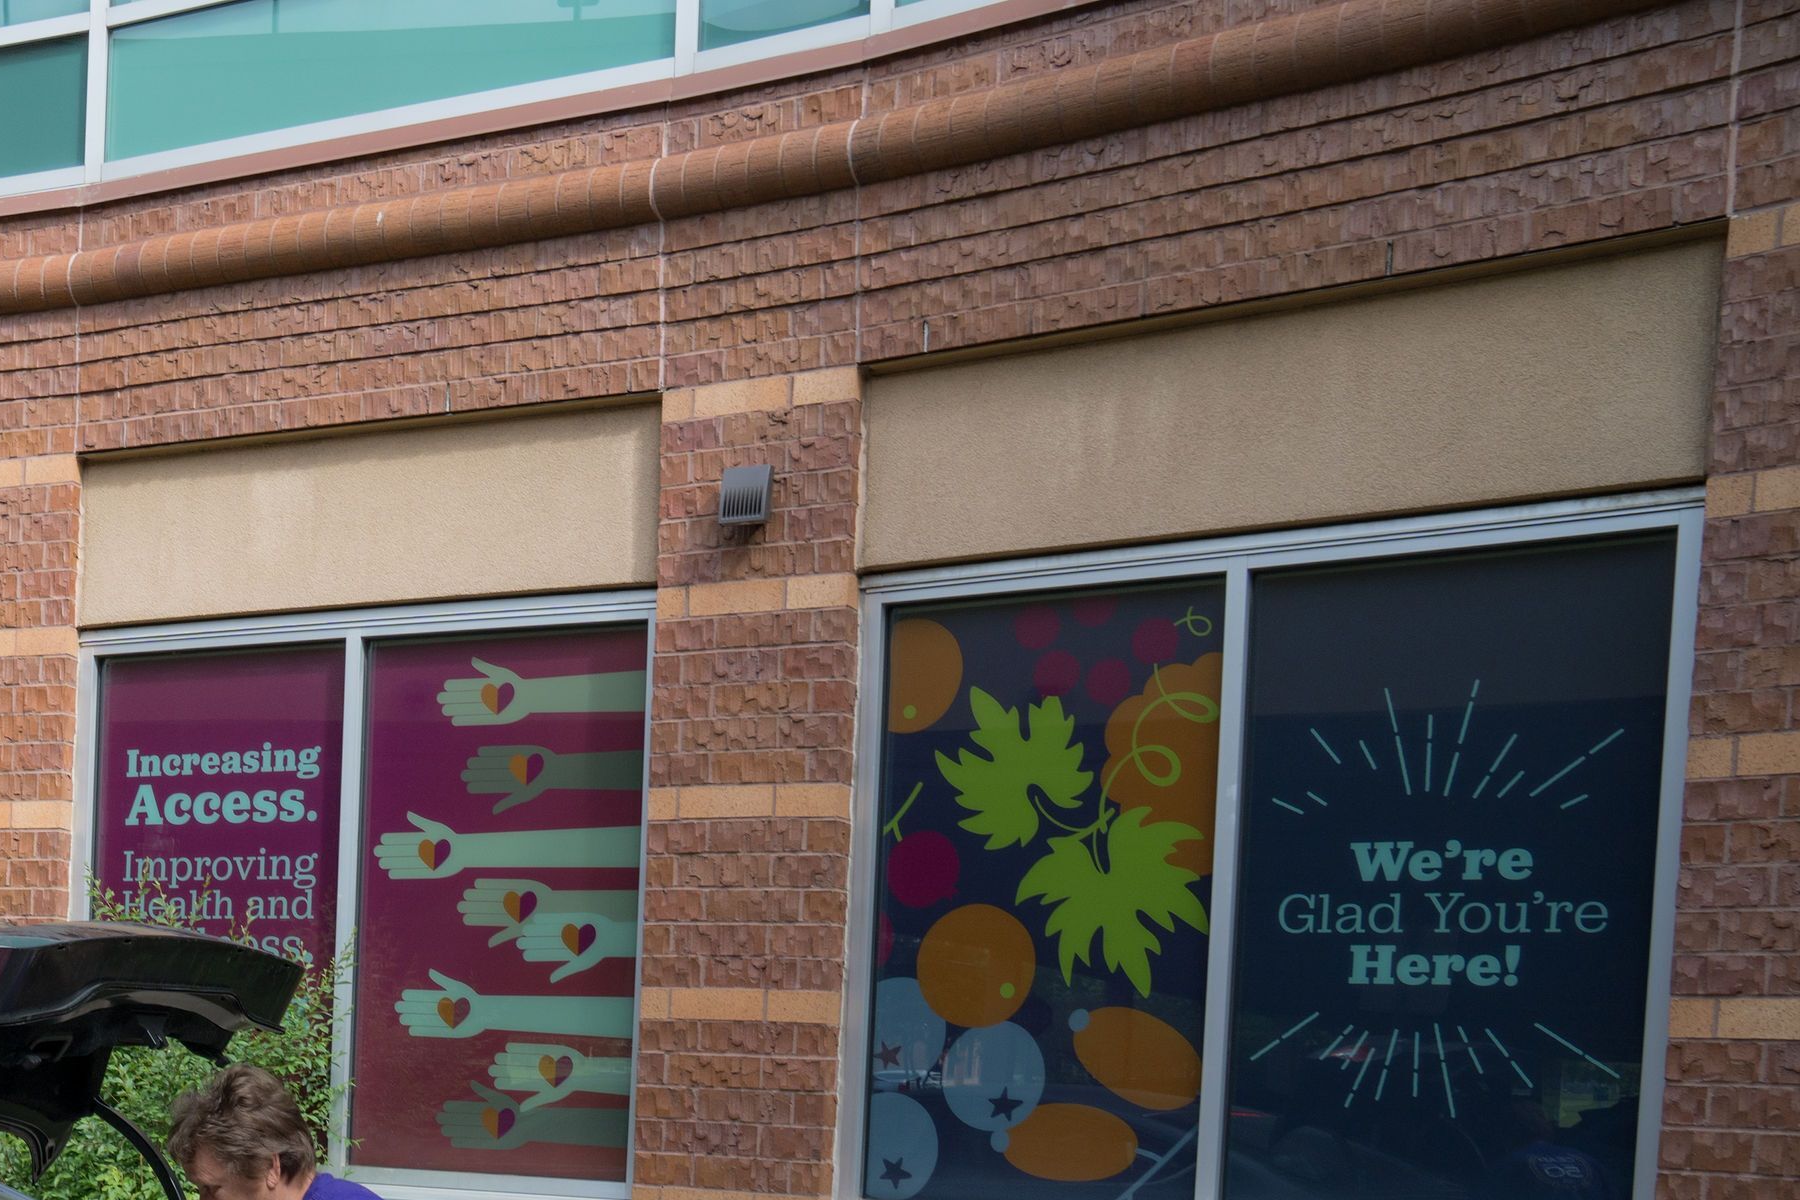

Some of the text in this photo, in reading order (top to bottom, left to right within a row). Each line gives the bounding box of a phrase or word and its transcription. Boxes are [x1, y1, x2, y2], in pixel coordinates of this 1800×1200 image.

[125, 742, 321, 779] Increasing
[125, 784, 318, 826] Access.
[122, 847, 319, 889] Improving
[1350, 840, 1533, 882] We're
[249, 889, 315, 920] and
[1278, 891, 1609, 934] Glad You're
[1348, 944, 1521, 988] Here!
